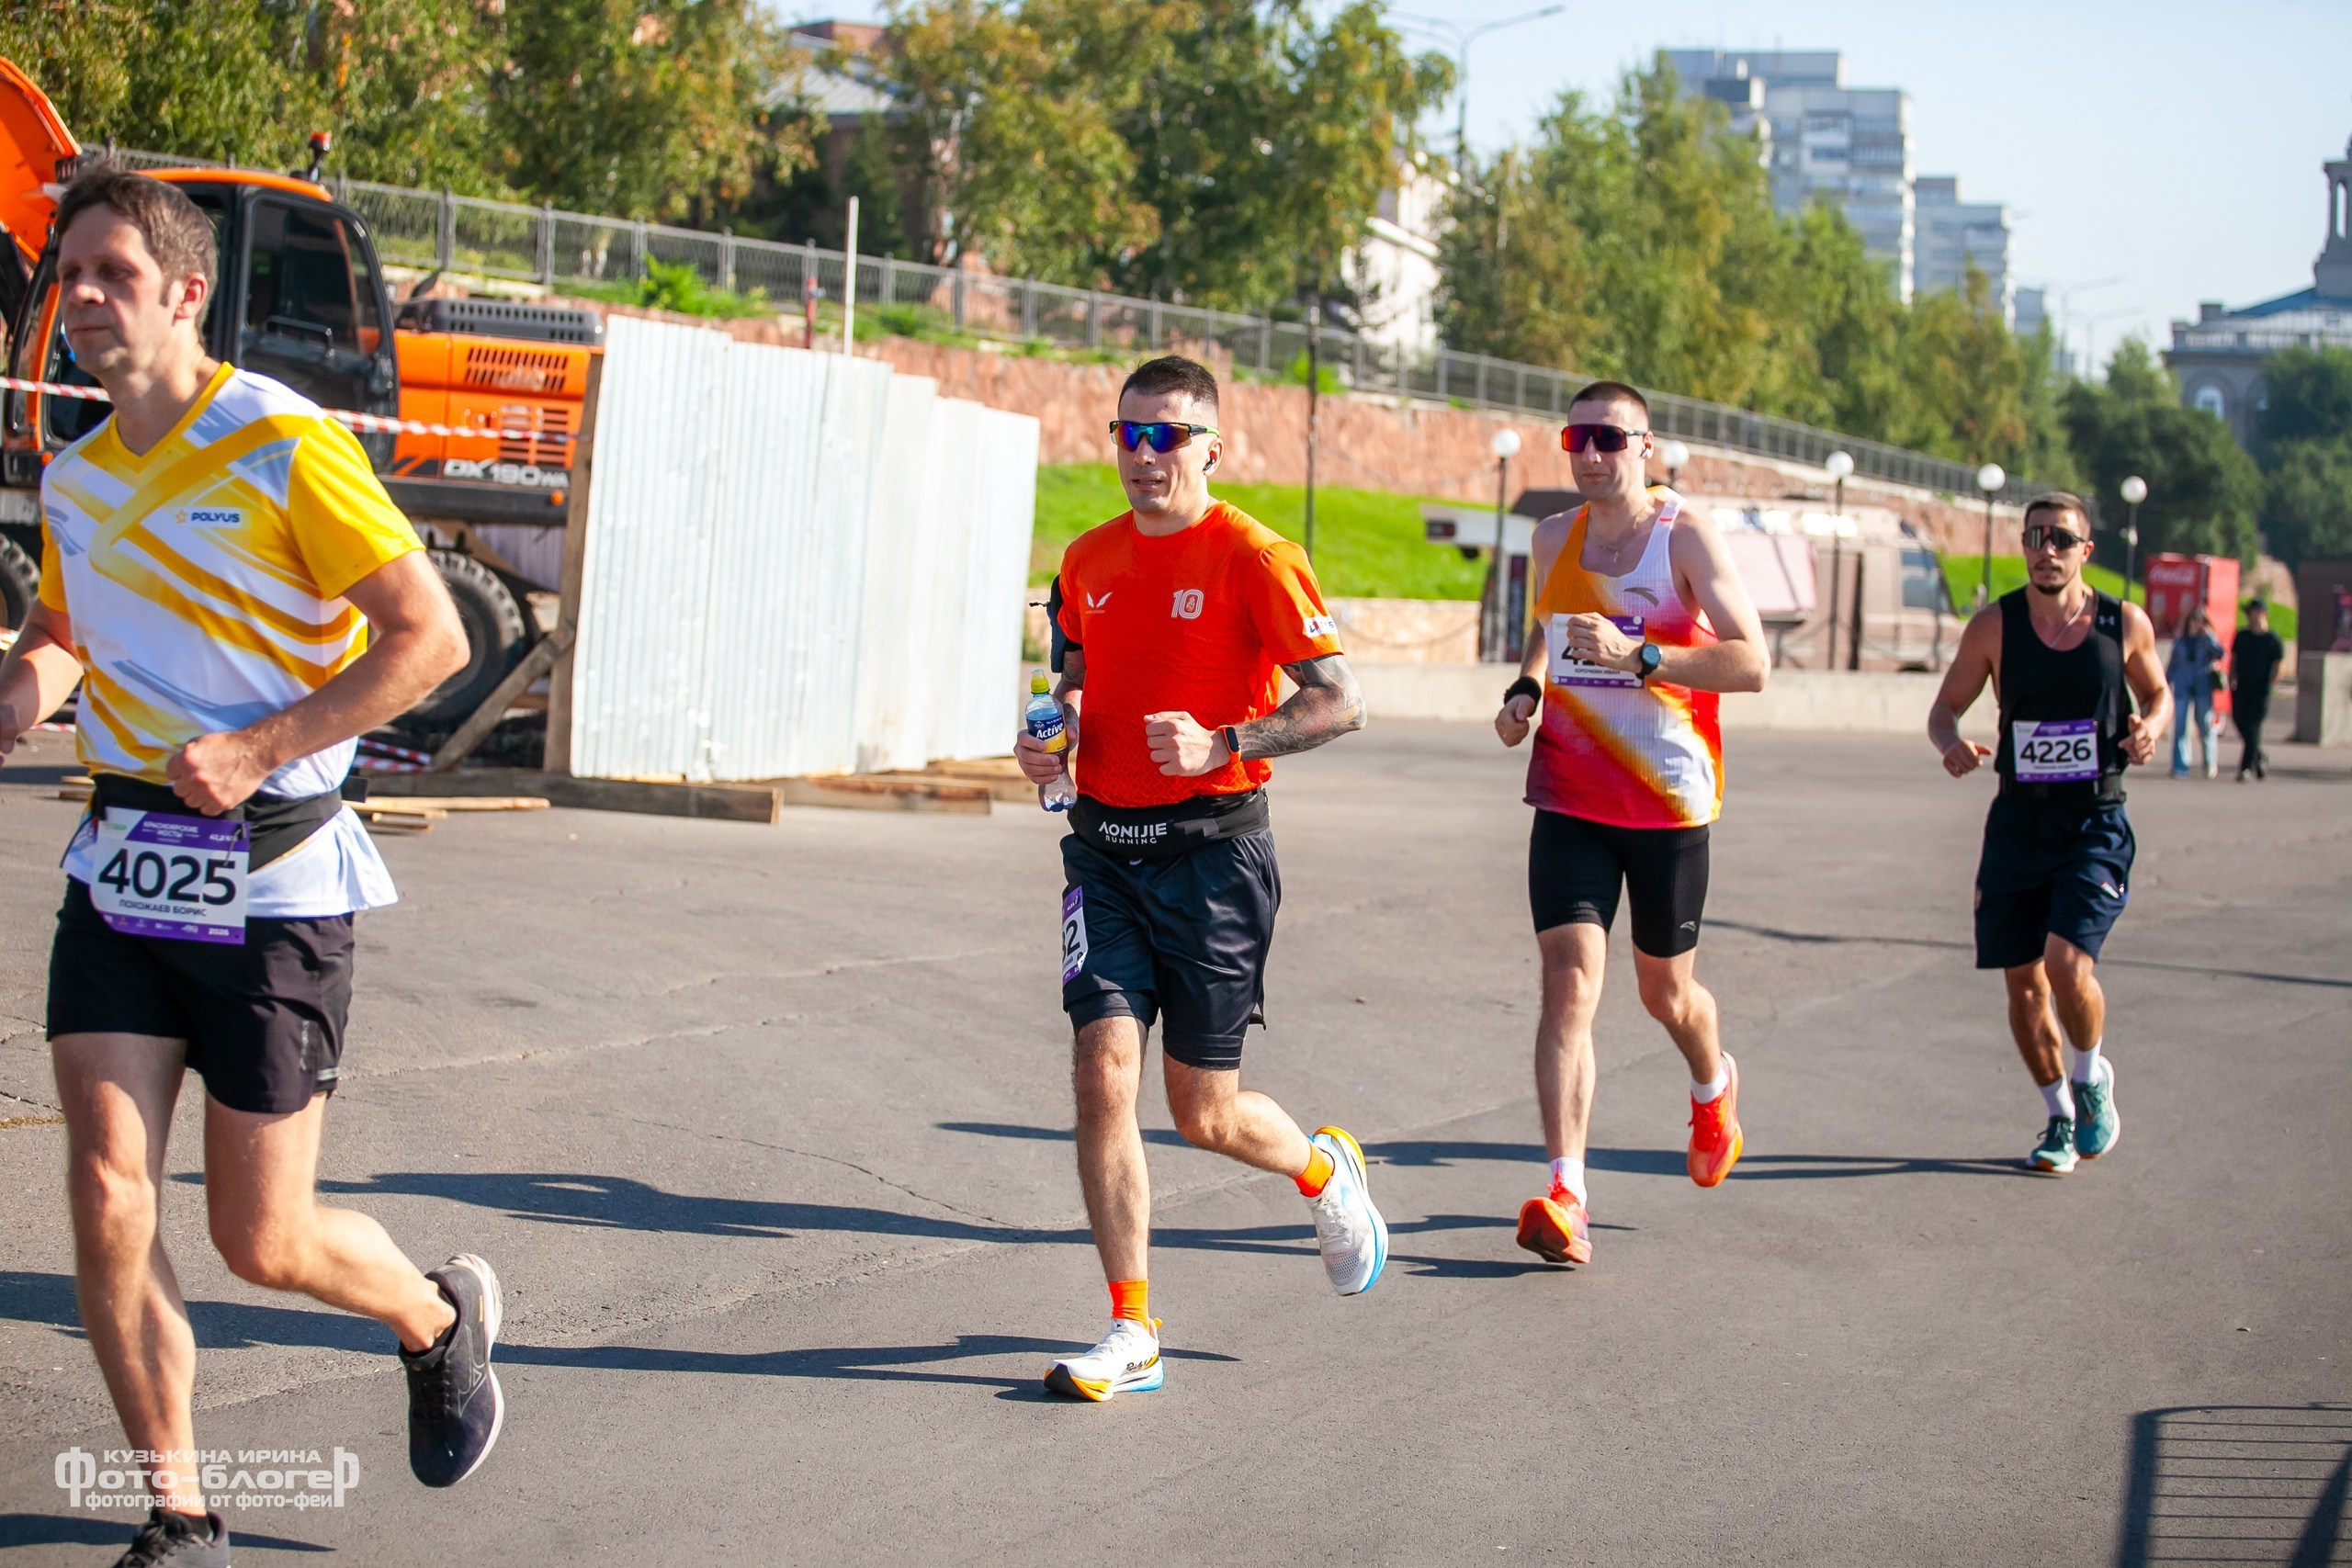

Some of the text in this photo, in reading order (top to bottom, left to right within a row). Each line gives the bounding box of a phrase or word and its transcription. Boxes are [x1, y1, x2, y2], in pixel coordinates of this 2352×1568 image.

[191, 512, 240, 523] POLYUS
[1170, 589, 1204, 619] 10
[1036, 723, 1063, 739] Active
[2019, 738, 2091, 763] 4226
[1105, 835, 1157, 845] RUNNING
[98, 848, 236, 906] 4025
[173, 906, 208, 917] БОРИС
